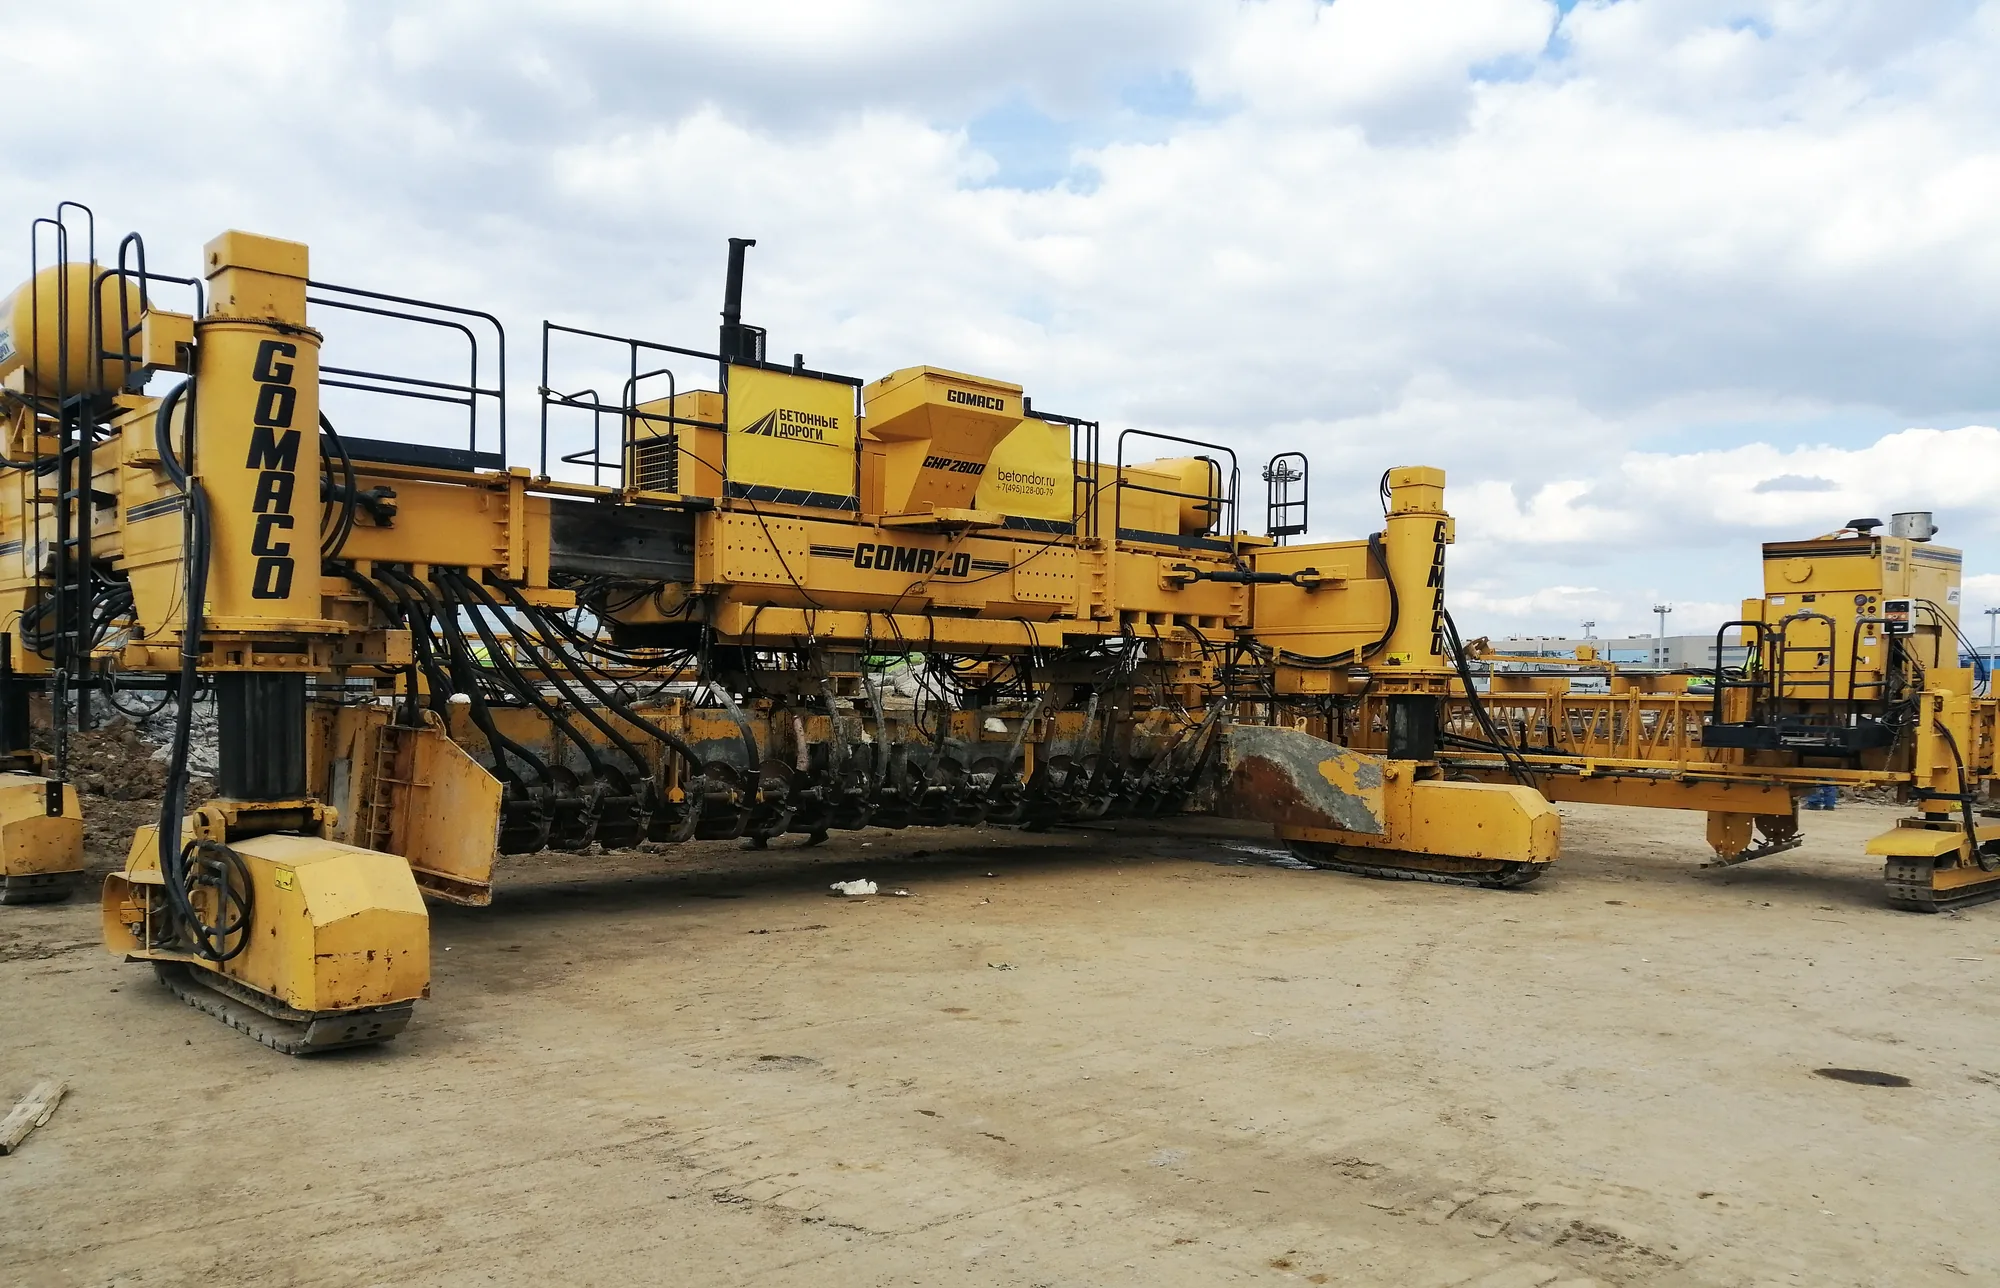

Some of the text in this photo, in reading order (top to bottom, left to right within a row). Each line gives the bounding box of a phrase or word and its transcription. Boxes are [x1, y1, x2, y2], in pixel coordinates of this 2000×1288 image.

[947, 389, 1004, 411] GOMACO
[779, 408, 839, 430] БЕТОННЫЕ
[779, 422, 823, 441] ДОРОГИ
[246, 340, 301, 600] GOMACO
[997, 467, 1056, 487] betondor.ru
[1426, 520, 1446, 656] GOMACO
